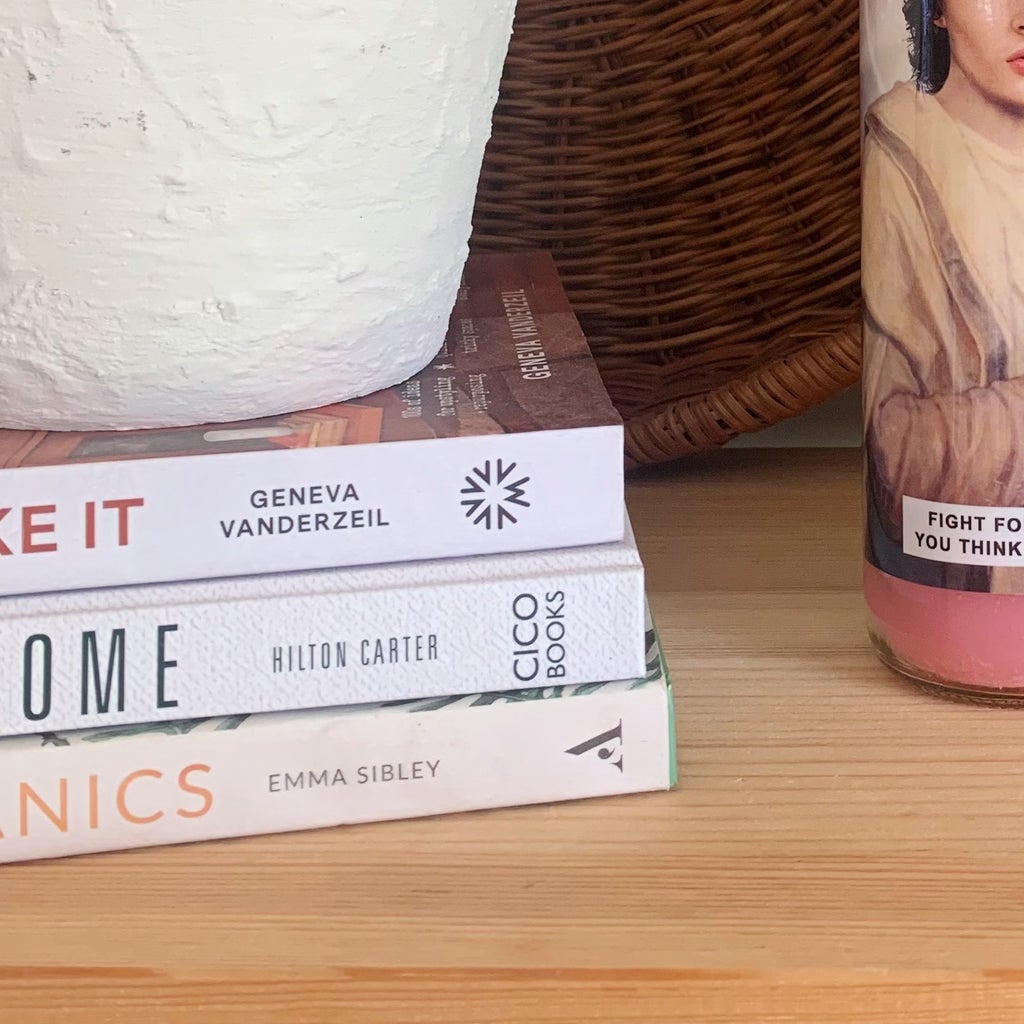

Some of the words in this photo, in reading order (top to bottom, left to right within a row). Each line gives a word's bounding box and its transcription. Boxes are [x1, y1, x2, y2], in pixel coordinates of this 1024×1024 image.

[501, 288, 539, 338] VANDERZEIL
[514, 338, 552, 381] GENEVA
[250, 483, 359, 509] GENEVA
[85, 497, 144, 549] IT
[220, 508, 390, 538] VANDERZEIL
[928, 511, 985, 531] FIGHT
[915, 531, 951, 552] YOU
[959, 539, 1022, 556] THINK
[273, 641, 347, 673] HILTON
[361, 634, 438, 666] CARTER
[512, 593, 539, 681] CICO
[545, 590, 566, 678] BOOKS
[23, 623, 179, 721] OME
[269, 768, 347, 792] EMMA
[357, 759, 440, 784] SIBLEY
[0, 763, 214, 839] NICS
